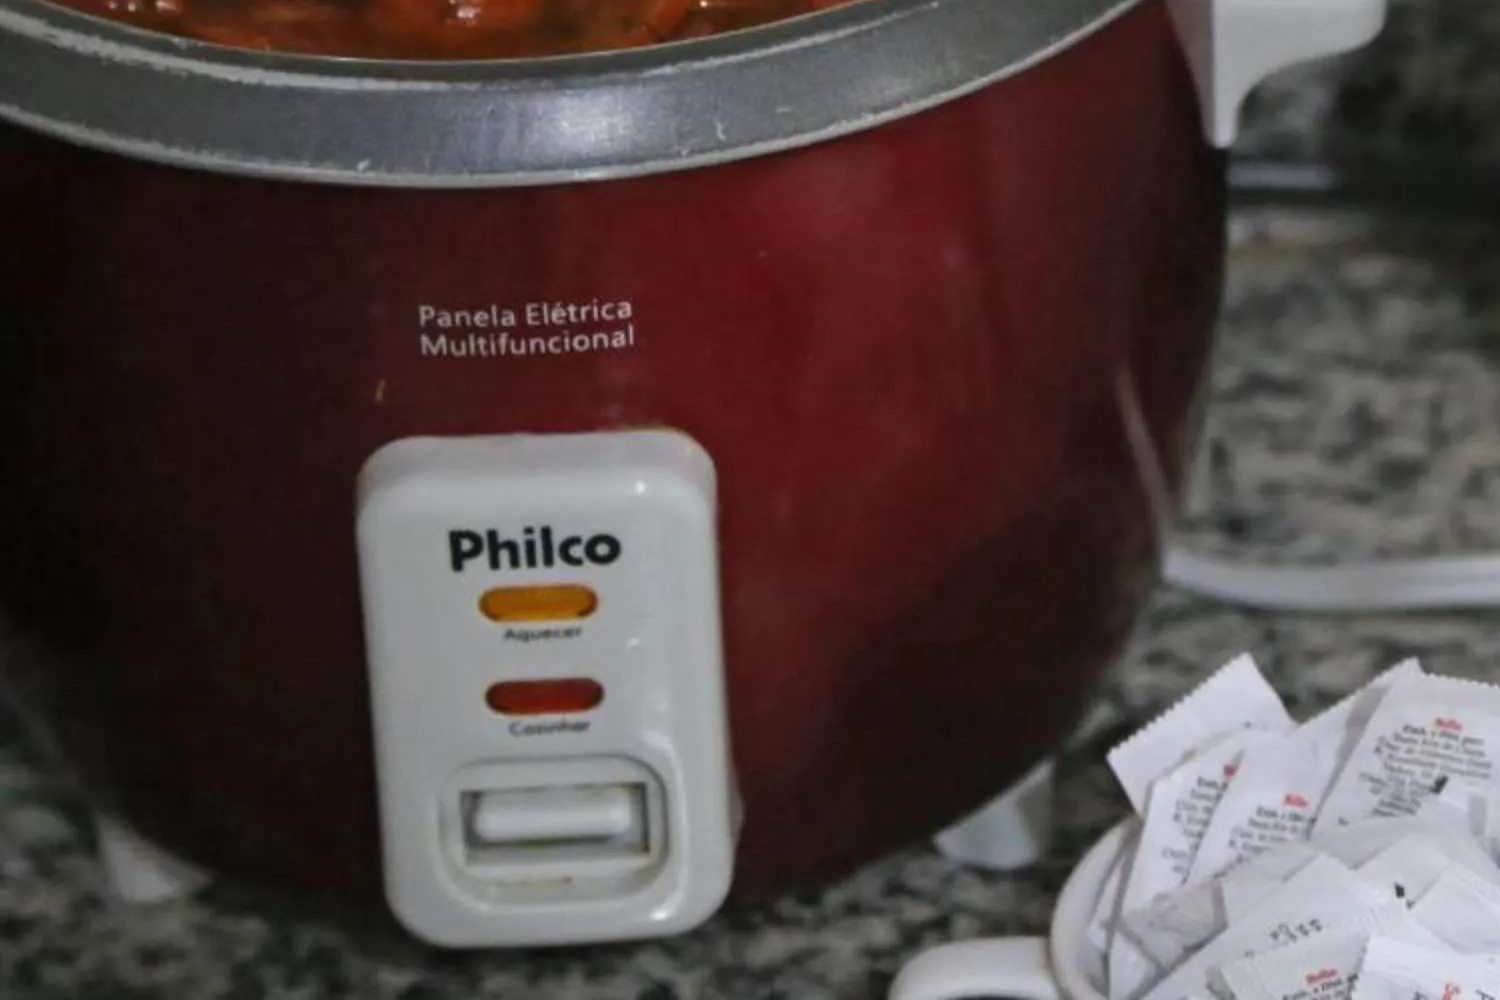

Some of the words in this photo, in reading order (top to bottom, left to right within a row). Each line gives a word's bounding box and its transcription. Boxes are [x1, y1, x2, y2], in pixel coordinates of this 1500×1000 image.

[418, 304, 517, 327] Panela
[525, 298, 633, 326] Elétrica
[419, 324, 635, 357] Multifuncional
[449, 526, 622, 573] Philco
